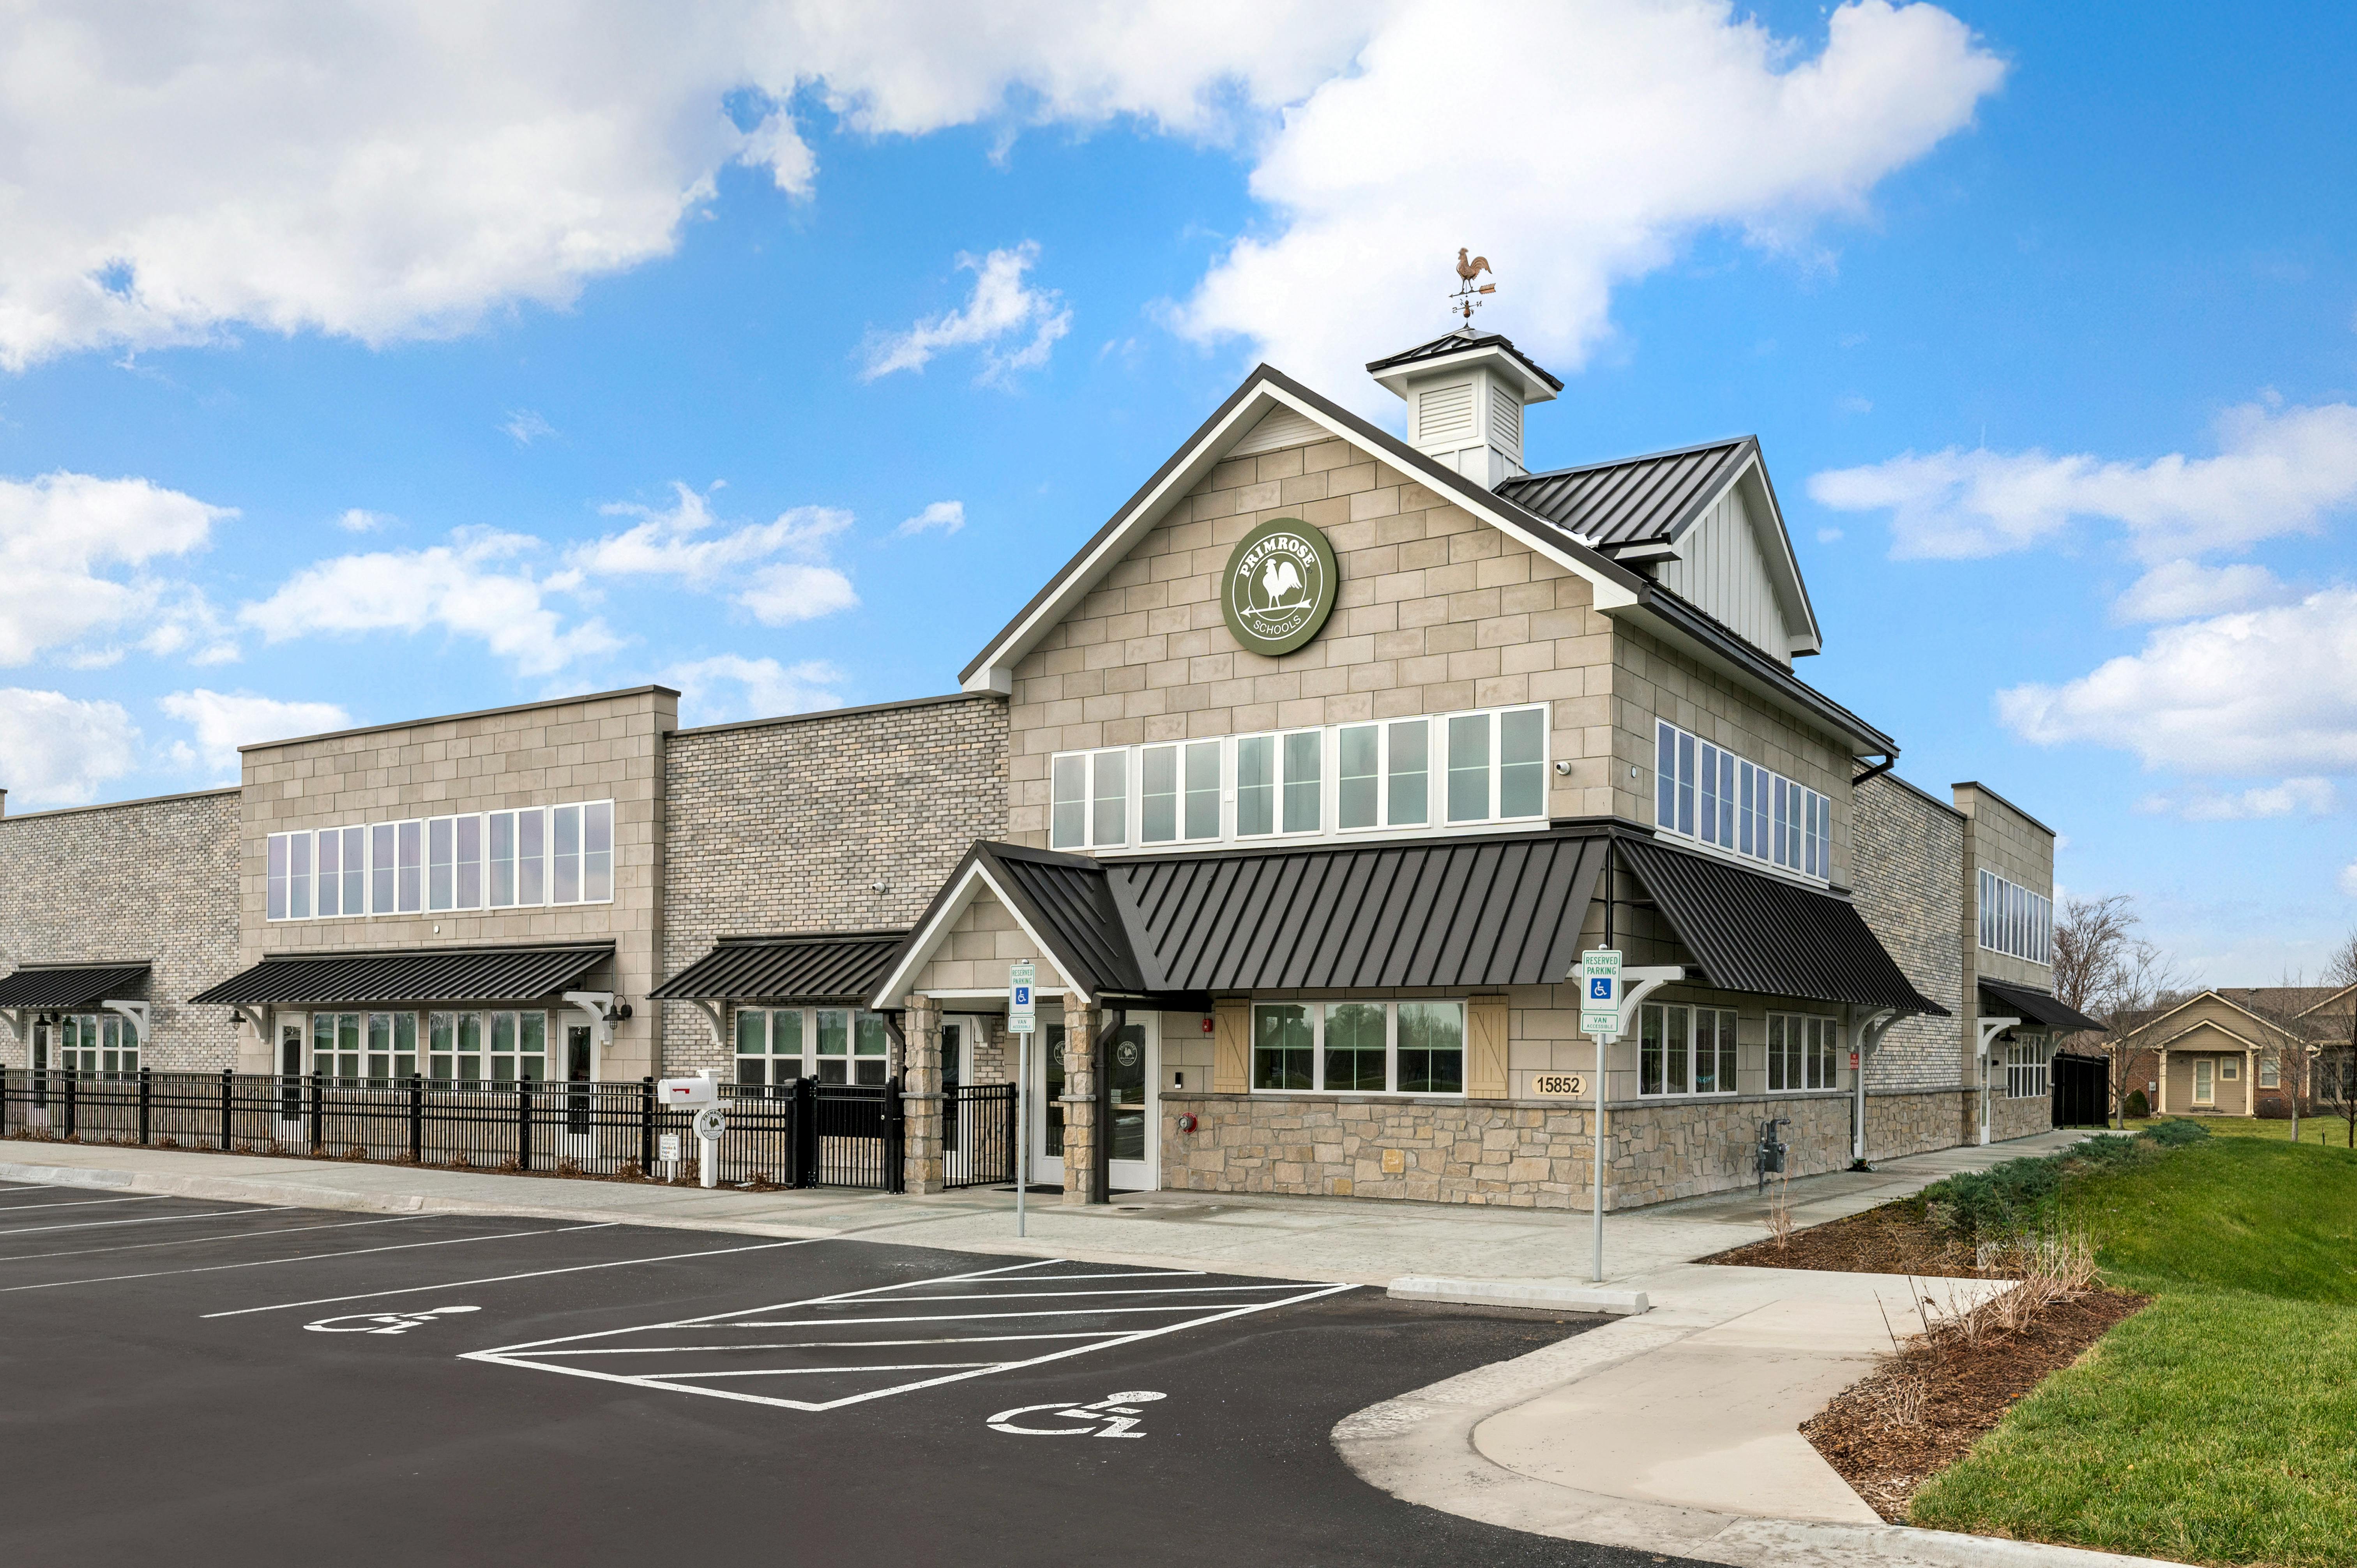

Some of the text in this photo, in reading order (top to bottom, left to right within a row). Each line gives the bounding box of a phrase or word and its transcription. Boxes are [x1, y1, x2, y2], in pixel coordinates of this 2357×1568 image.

[1240, 537, 1315, 577] PRIMROSE
[1253, 615, 1301, 634] SCHOOLS
[1586, 957, 1618, 965] RESERVED
[1587, 967, 1616, 975] PARKING
[1537, 1077, 1579, 1093] 15852
[703, 1111, 724, 1121] PRIMROSE
